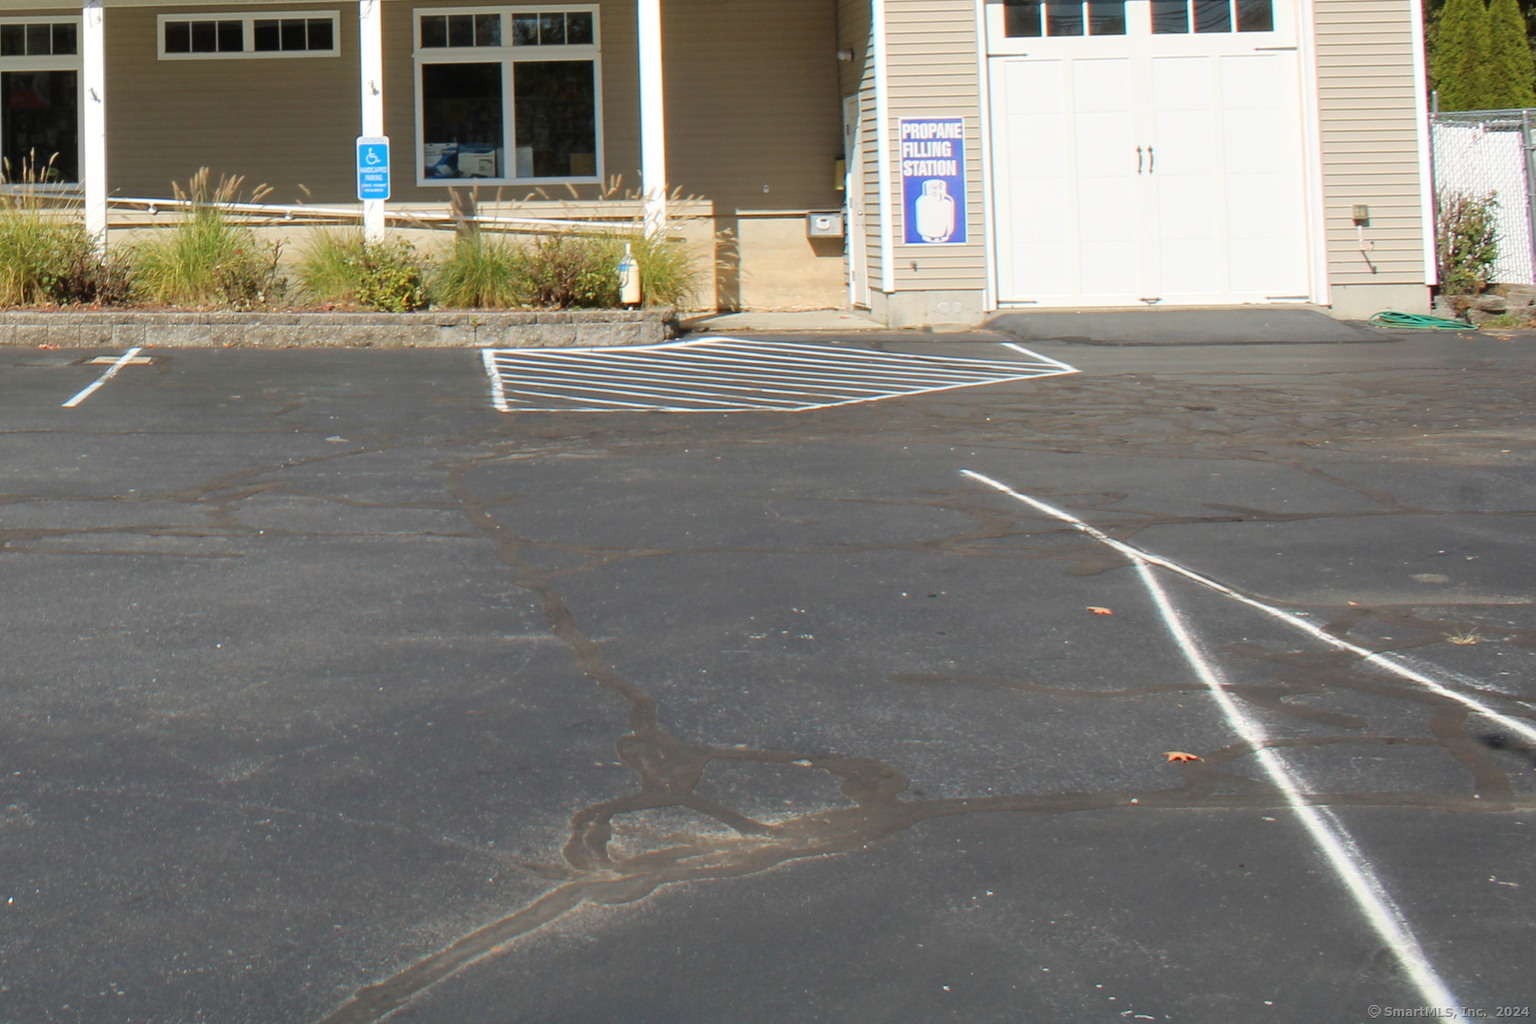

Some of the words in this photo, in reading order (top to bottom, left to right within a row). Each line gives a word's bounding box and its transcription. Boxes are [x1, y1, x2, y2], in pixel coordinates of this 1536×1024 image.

[901, 122, 963, 139] PROPANE
[902, 141, 952, 158] FILLING
[903, 159, 957, 177] STATION
